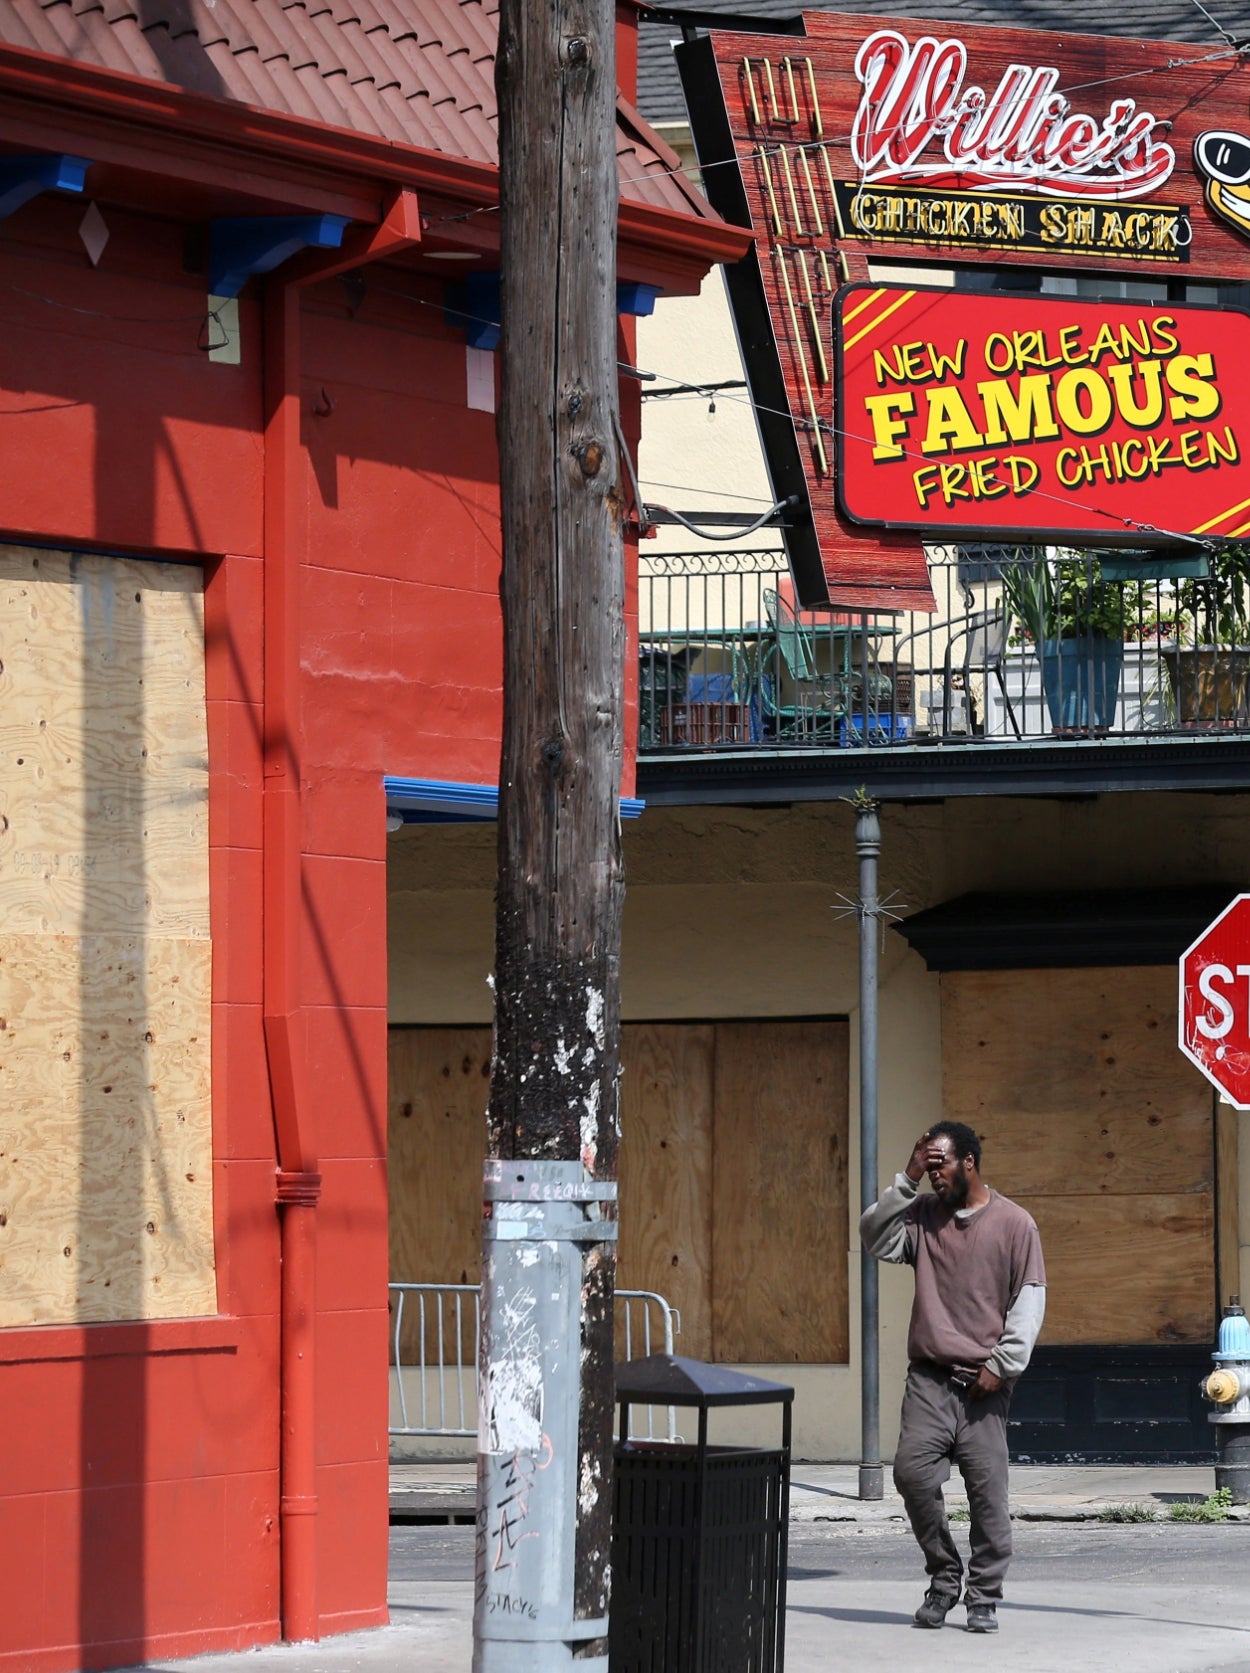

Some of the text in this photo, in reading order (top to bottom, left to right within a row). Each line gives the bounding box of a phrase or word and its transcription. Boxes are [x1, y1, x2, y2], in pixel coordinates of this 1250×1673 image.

[852, 30, 1175, 196] Willie's
[850, 193, 1186, 251] CHICKEN SHACK
[872, 315, 1178, 384] NEW ORLEANS
[864, 352, 1221, 461] FAMOUS
[912, 426, 1238, 506] FRIED CHICKEN
